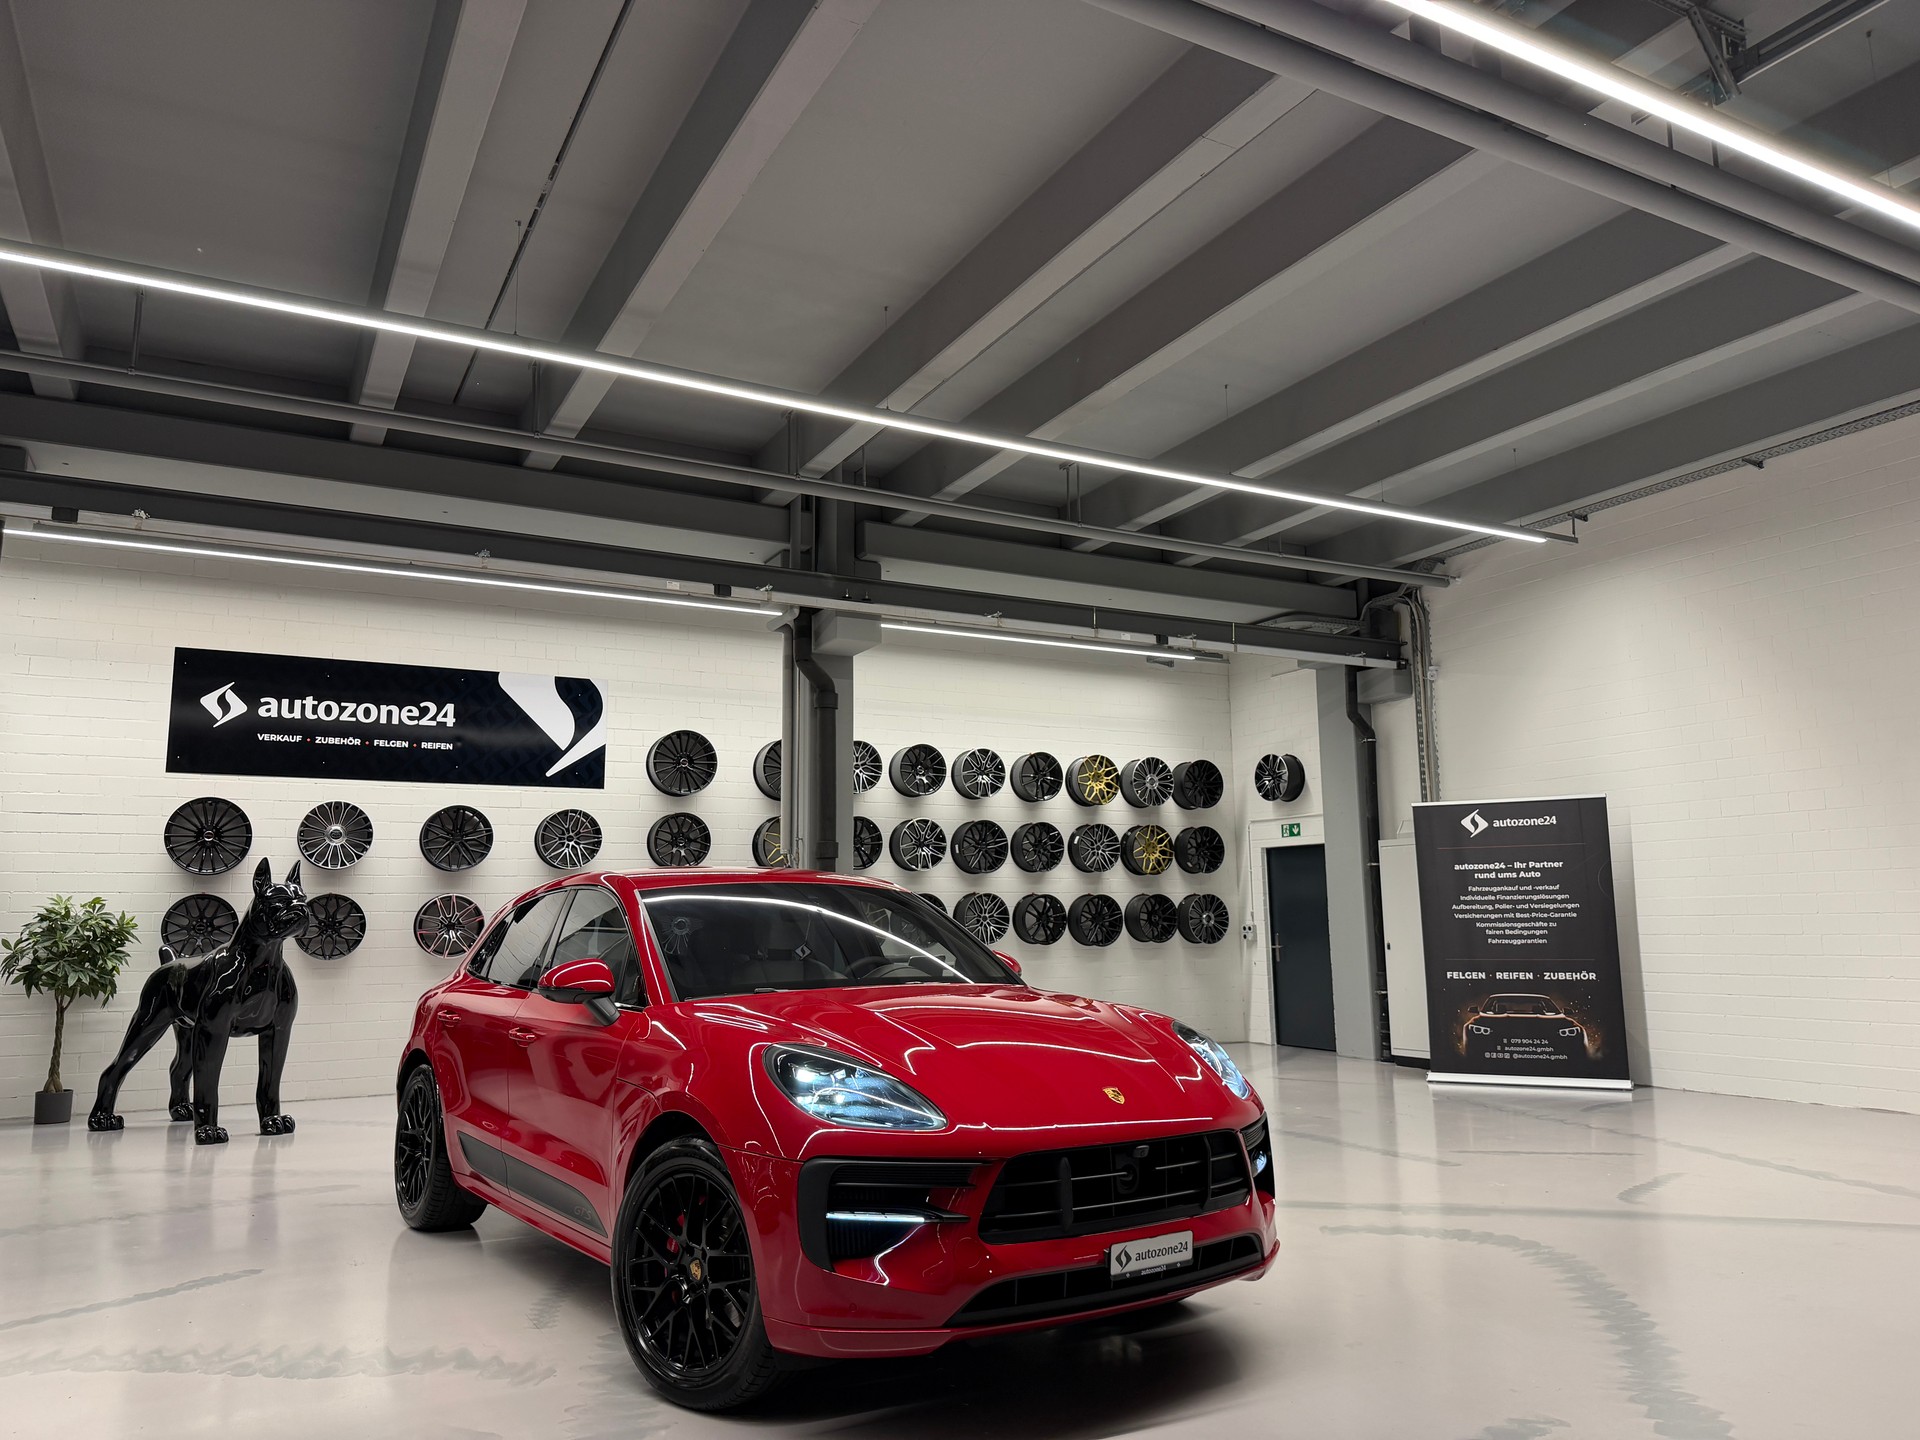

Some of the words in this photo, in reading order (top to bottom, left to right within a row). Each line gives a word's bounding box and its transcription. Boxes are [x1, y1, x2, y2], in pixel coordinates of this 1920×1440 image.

[258, 695, 456, 727] autozone24
[257, 733, 303, 743] VERKAUF
[315, 735, 362, 747] ZUBEHÖR
[373, 739, 409, 748] FELGEN
[421, 742, 454, 751] REIFEN
[1493, 815, 1557, 828] autozone24
[1454, 861, 1506, 871] autozone24
[1514, 861, 1527, 869] Ihr
[1528, 860, 1563, 869] Partner
[1474, 870, 1496, 879] rund
[1519, 870, 1541, 878] Auto
[1468, 885, 1519, 893] Fahrzeugankauf
[1496, 893, 1570, 901] Finanzierungslösungen
[1529, 902, 1580, 910] Versiegelungen
[1447, 971, 1486, 980] FELGEN
[1496, 972, 1533, 980] REIFEN
[1543, 970, 1597, 981] ZUBEHÖR
[1512, 1053, 1568, 1061] @autozone24.gmbh
[1135, 1241, 1189, 1262] autozone24
[1141, 1265, 1166, 1275] autozone24
